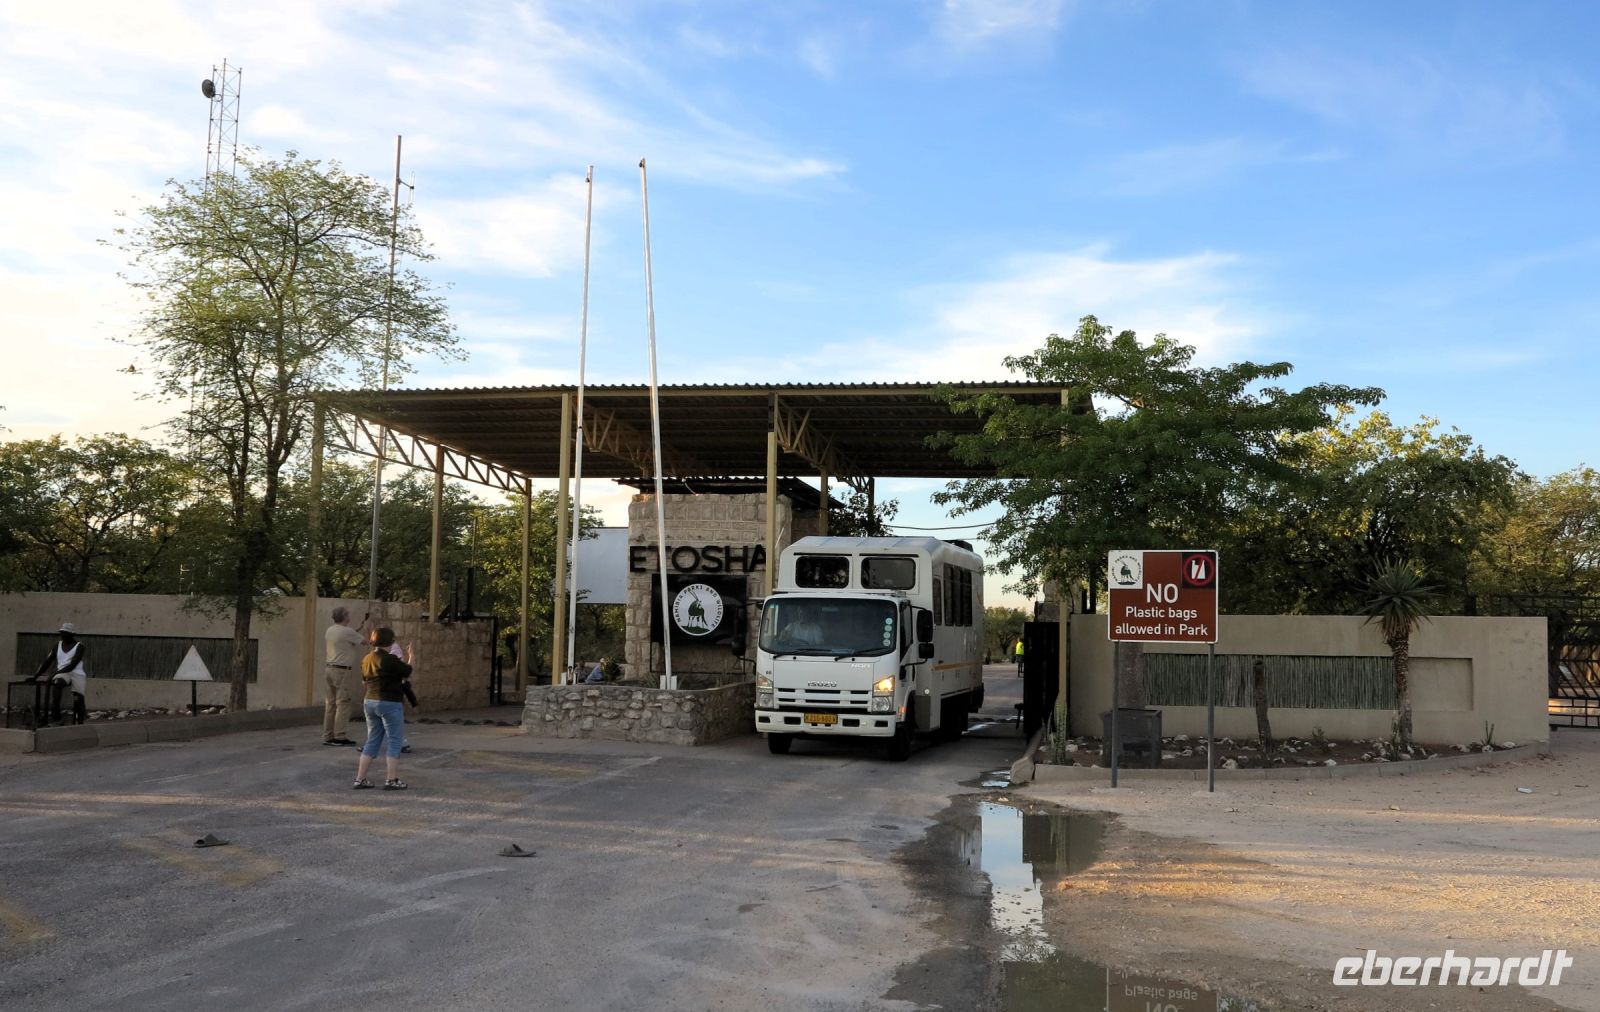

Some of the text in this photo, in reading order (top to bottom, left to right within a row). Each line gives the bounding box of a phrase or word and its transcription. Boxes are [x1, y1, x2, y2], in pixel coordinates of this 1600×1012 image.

[684, 585, 702, 595] PARKS
[705, 587, 718, 598] AND
[1146, 583, 1179, 604] NO
[1125, 606, 1198, 621] Plastic bags
[1115, 623, 1208, 636] allowed in Park
[807, 680, 838, 688] ISUZU
